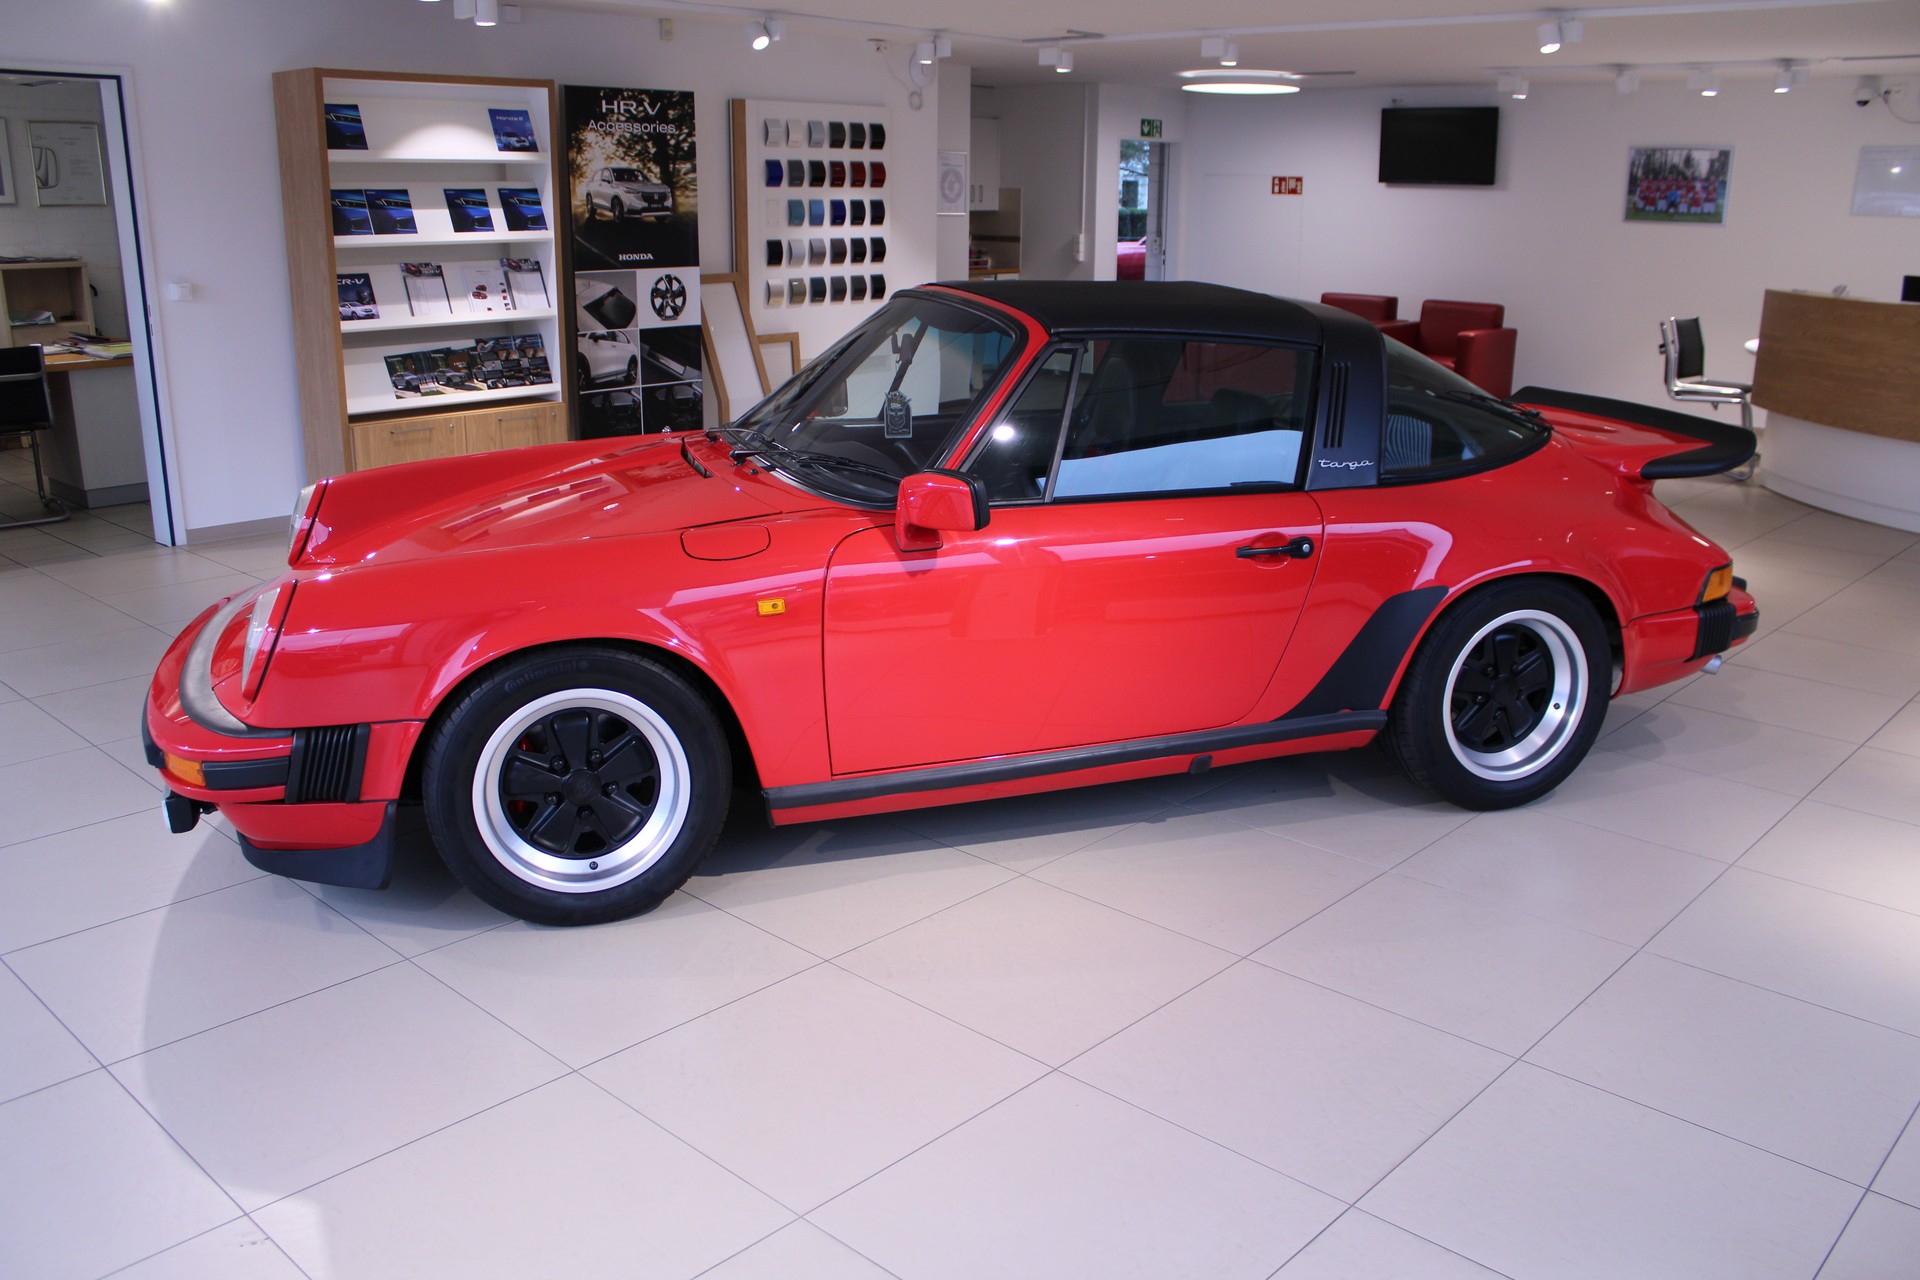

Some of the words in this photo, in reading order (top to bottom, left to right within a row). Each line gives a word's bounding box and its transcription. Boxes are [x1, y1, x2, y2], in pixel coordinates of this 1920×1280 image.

[601, 99, 661, 115] HR-V
[587, 120, 676, 133] Accessories
[619, 253, 654, 261] HONDA
[1318, 458, 1375, 470] targa
[504, 660, 577, 692] Continental
